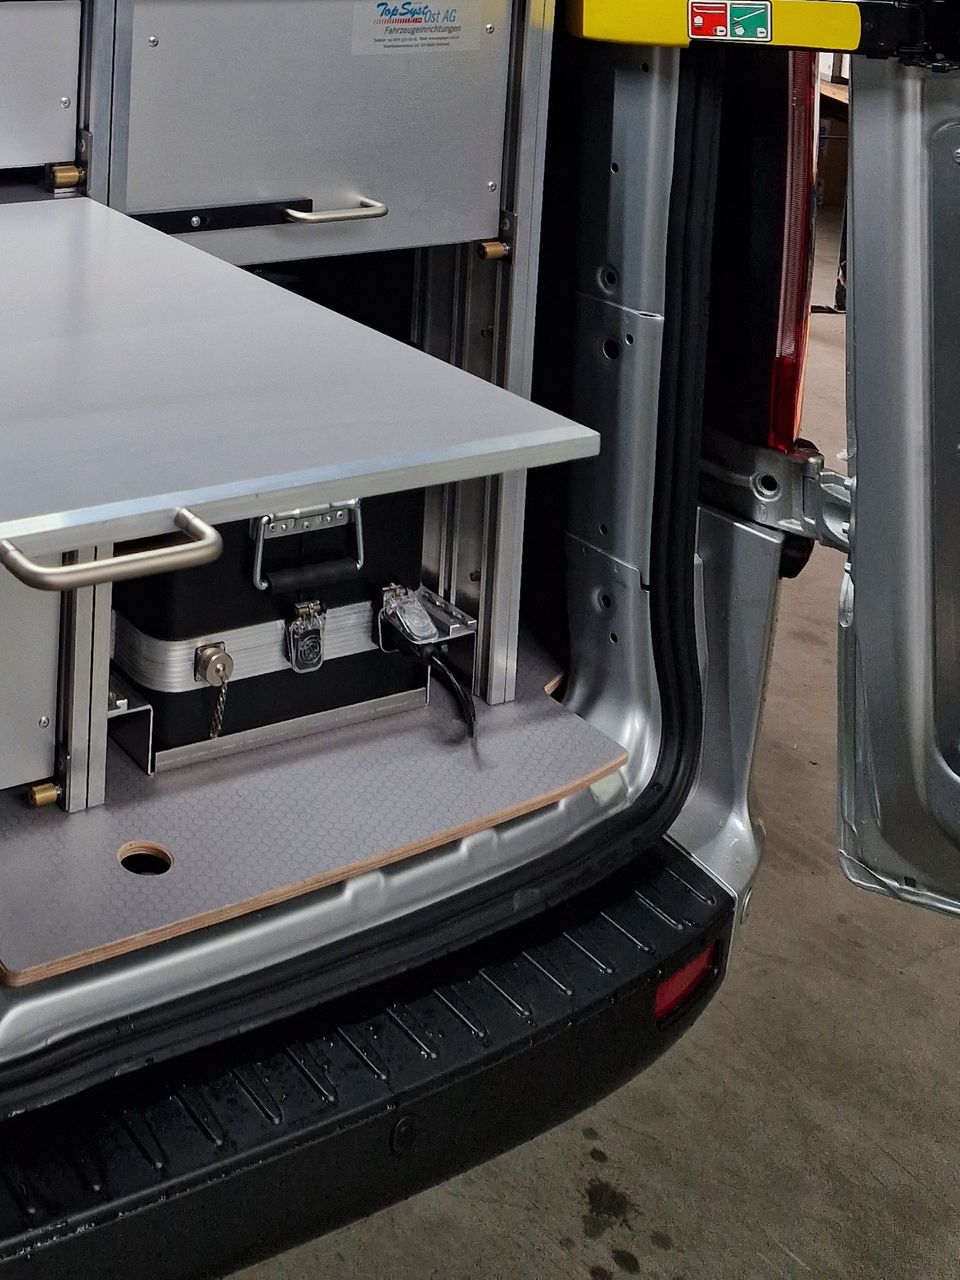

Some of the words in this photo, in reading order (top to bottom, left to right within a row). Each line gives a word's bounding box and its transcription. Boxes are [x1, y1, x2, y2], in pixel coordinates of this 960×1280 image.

[424, 10, 440, 23] Ost
[443, 8, 457, 23] AG
[384, 25, 462, 36] Fahrzeugeinrichtungen
